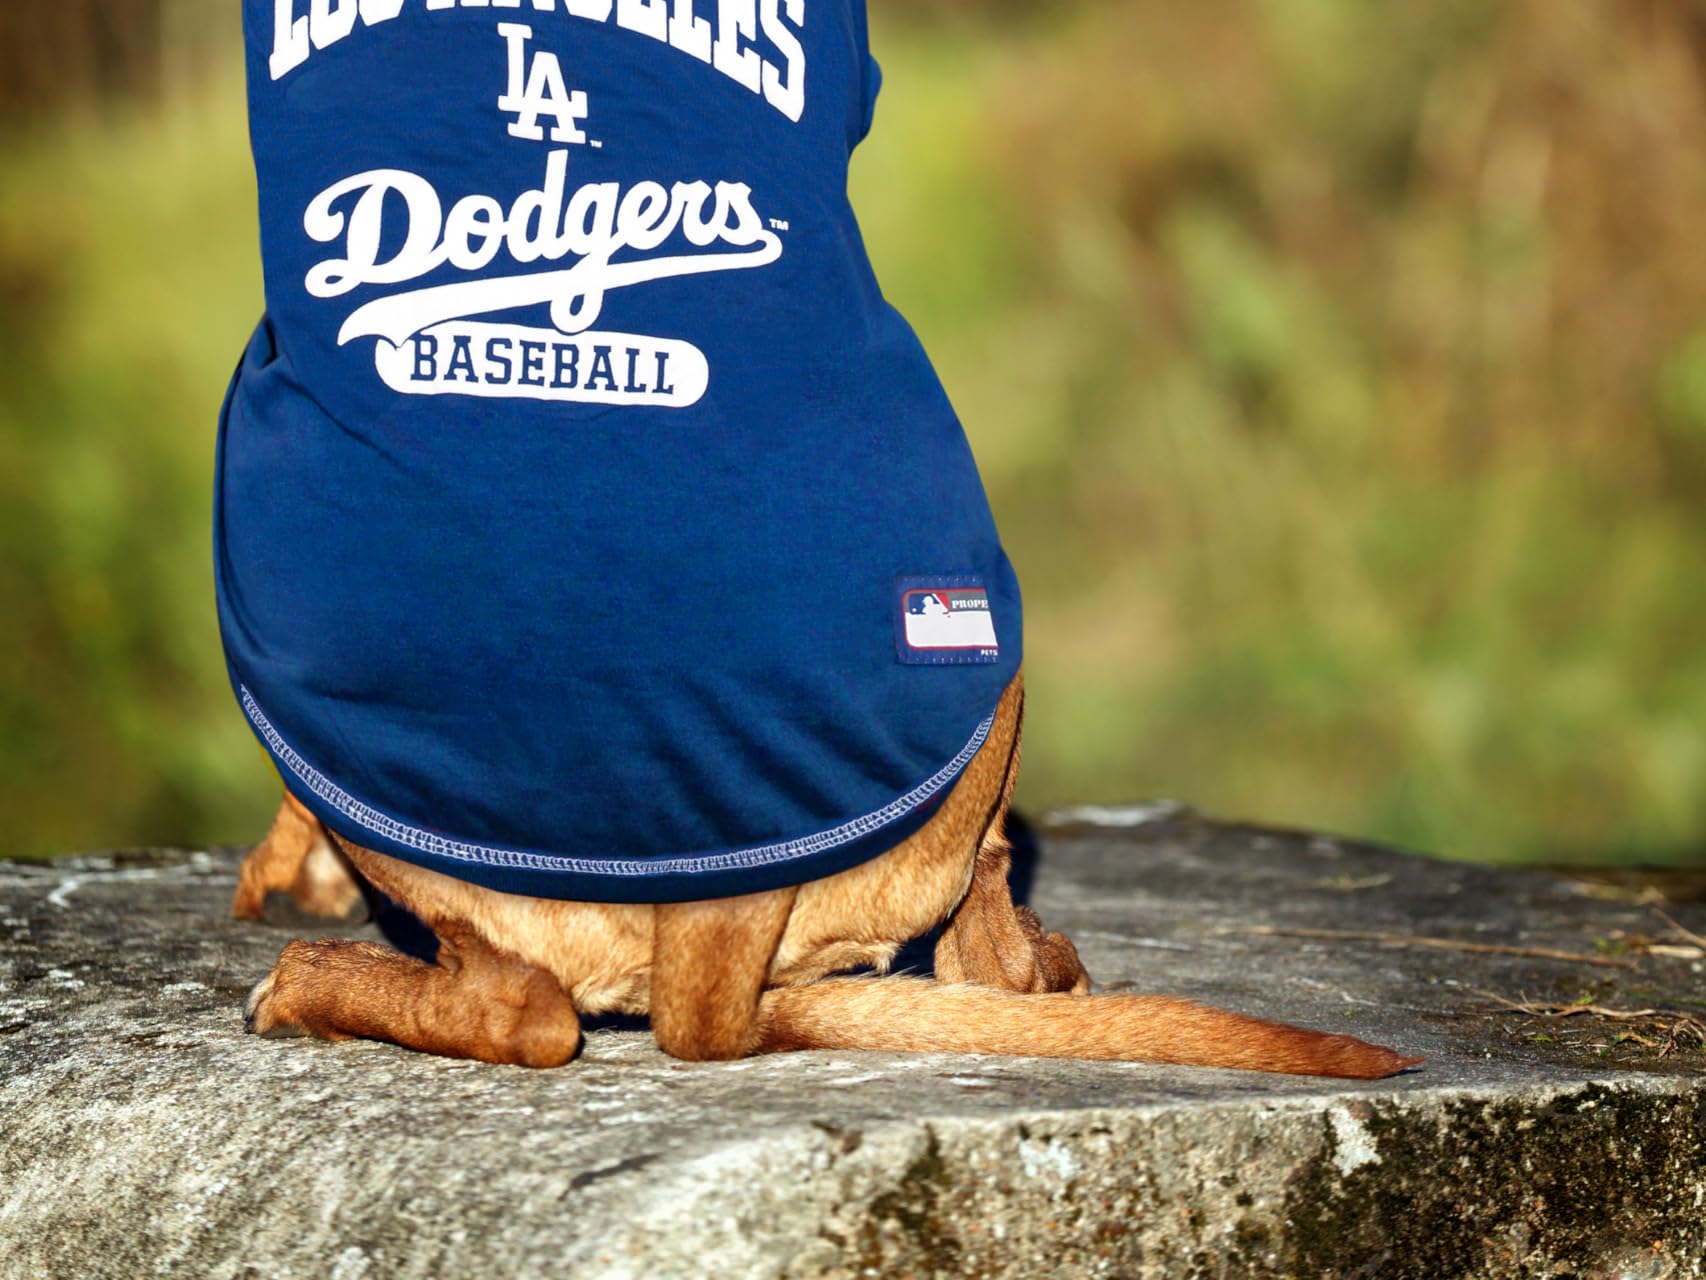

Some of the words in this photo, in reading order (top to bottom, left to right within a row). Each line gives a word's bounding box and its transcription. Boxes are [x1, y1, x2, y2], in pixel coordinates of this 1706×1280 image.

[497, 22, 588, 145] LA
[303, 149, 783, 334] Dodgers
[409, 333, 674, 395] BASEBALL
